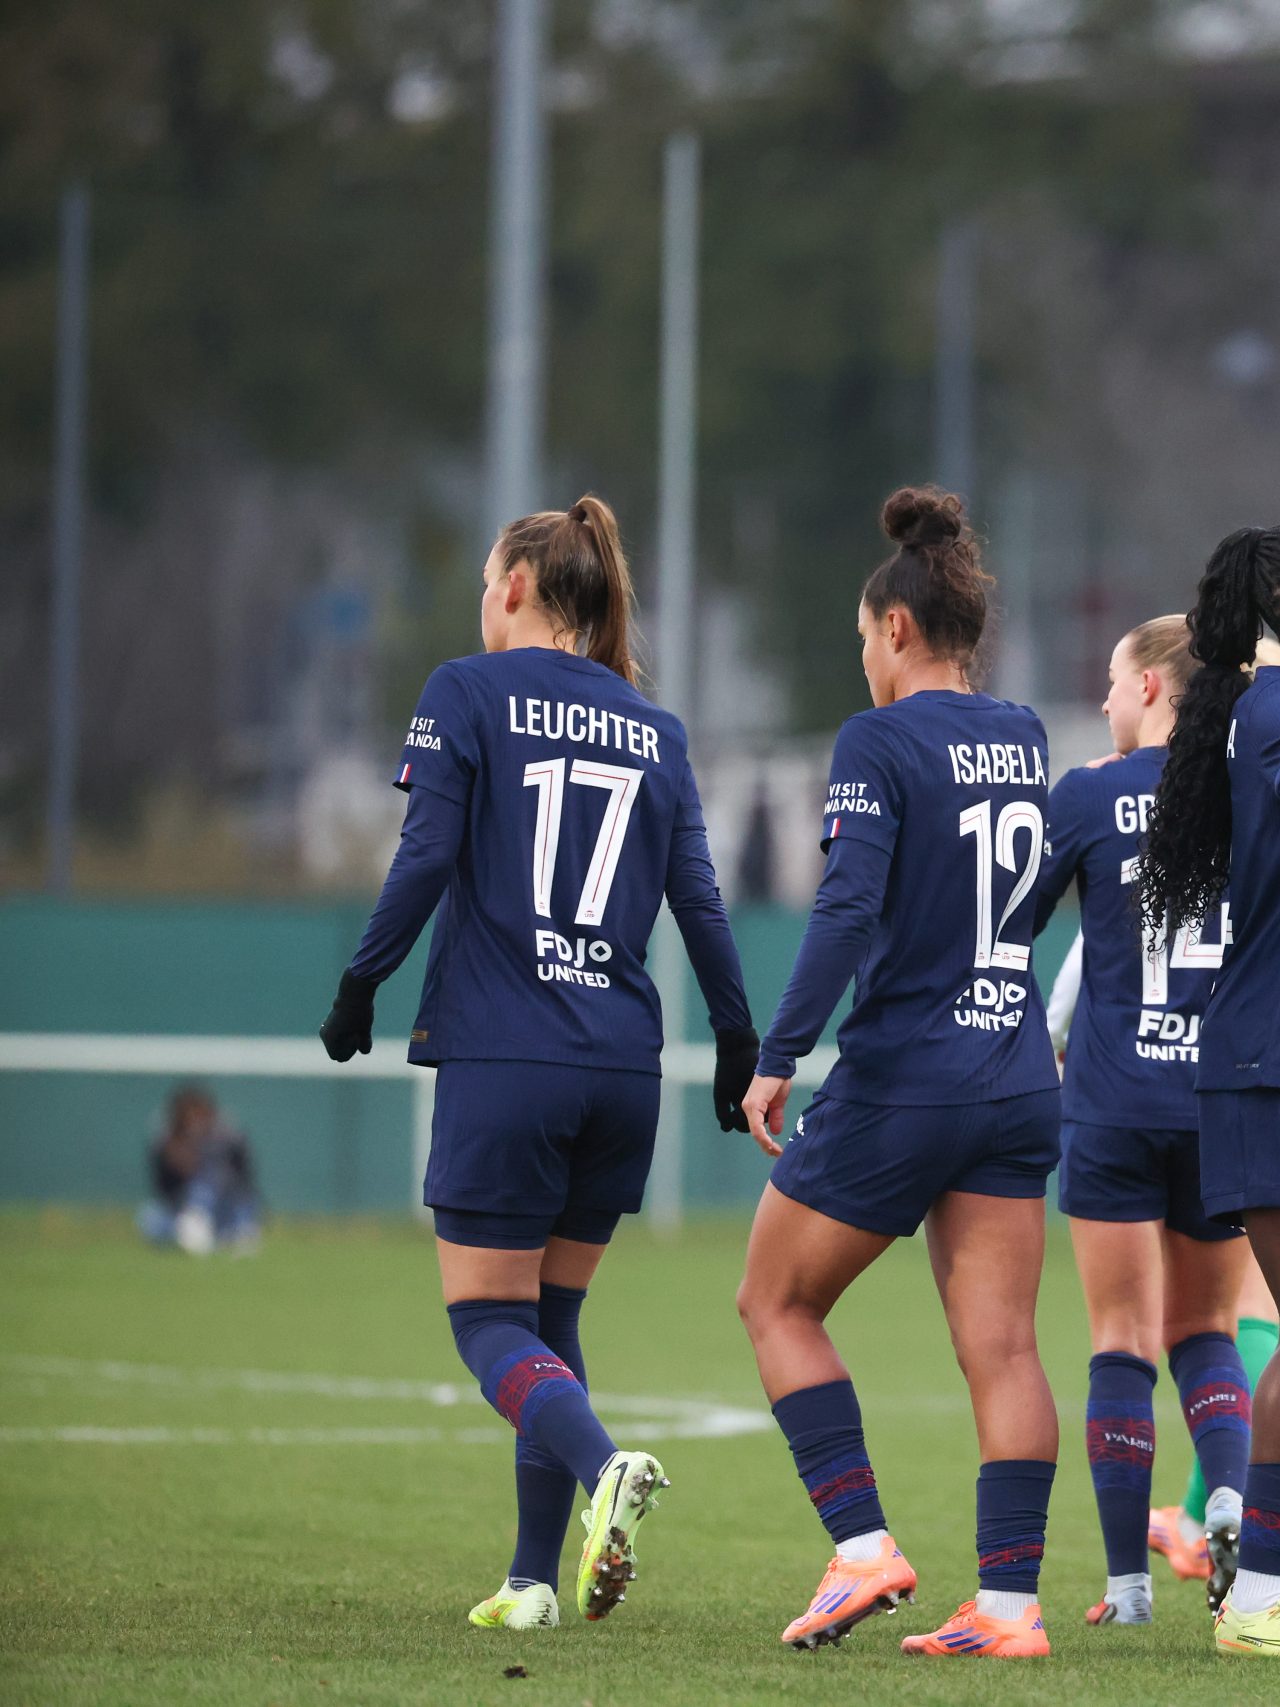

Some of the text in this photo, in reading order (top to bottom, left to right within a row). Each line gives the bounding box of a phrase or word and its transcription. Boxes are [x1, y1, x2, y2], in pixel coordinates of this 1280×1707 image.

[404, 731, 441, 751] ANDA
[410, 716, 436, 733] ISIT
[508, 695, 661, 764] LEUCHTER
[947, 743, 1047, 787] ISABELA
[829, 782, 868, 799] VISIT
[522, 757, 645, 927] 17
[959, 799, 1044, 972] 12
[537, 963, 611, 989] UNITED
